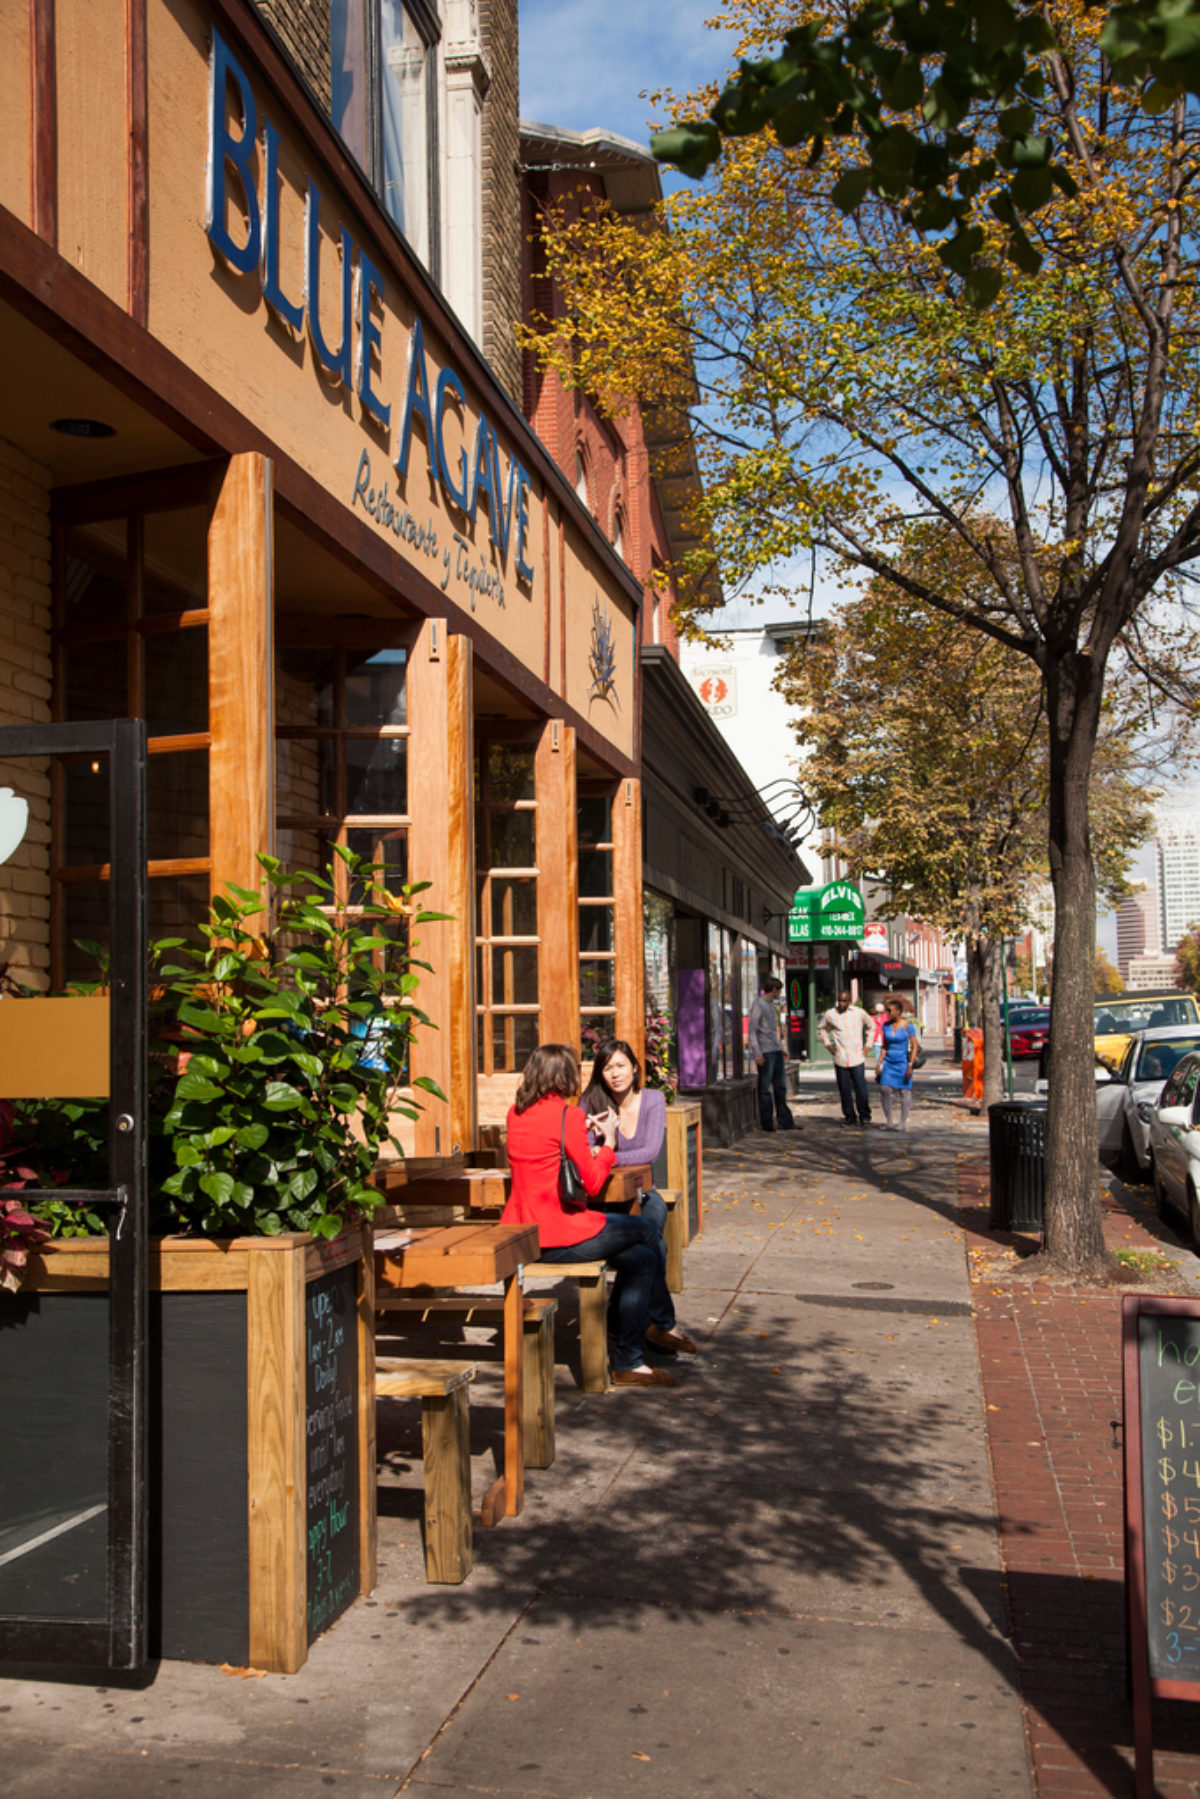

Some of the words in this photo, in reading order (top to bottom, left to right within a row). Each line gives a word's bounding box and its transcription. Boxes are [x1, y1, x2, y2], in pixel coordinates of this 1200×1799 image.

[204, 24, 391, 428] BLUE
[393, 314, 534, 585] AGAVE
[351, 447, 439, 558] Restaurante
[440, 547, 451, 591] y
